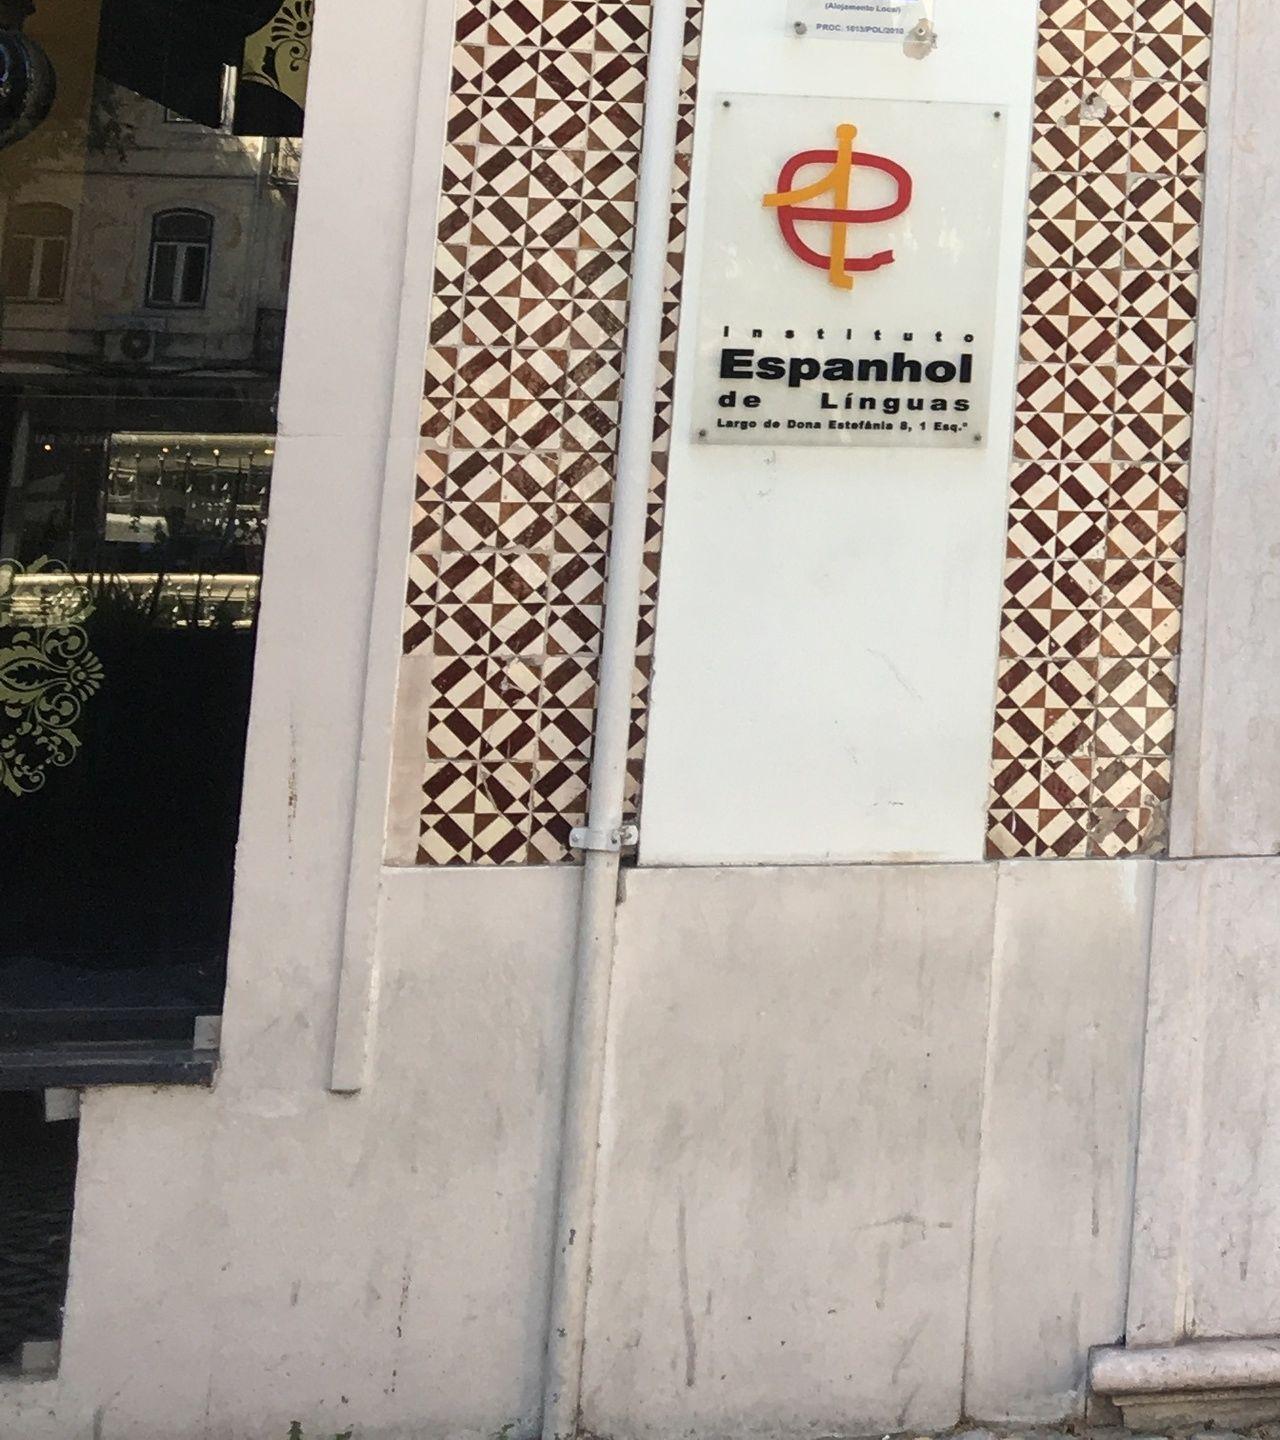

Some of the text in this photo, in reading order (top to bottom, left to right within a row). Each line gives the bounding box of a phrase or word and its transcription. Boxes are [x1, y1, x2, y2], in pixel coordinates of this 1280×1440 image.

[723, 325, 974, 343] Instituto
[719, 348, 973, 388] Espanhol
[718, 391, 970, 415] de Línguas
[717, 418, 757, 430] Largo
[763, 419, 781, 429] de
[787, 419, 821, 429] Dona
[828, 420, 893, 431] Estefânia
[919, 422, 926, 431] 1
